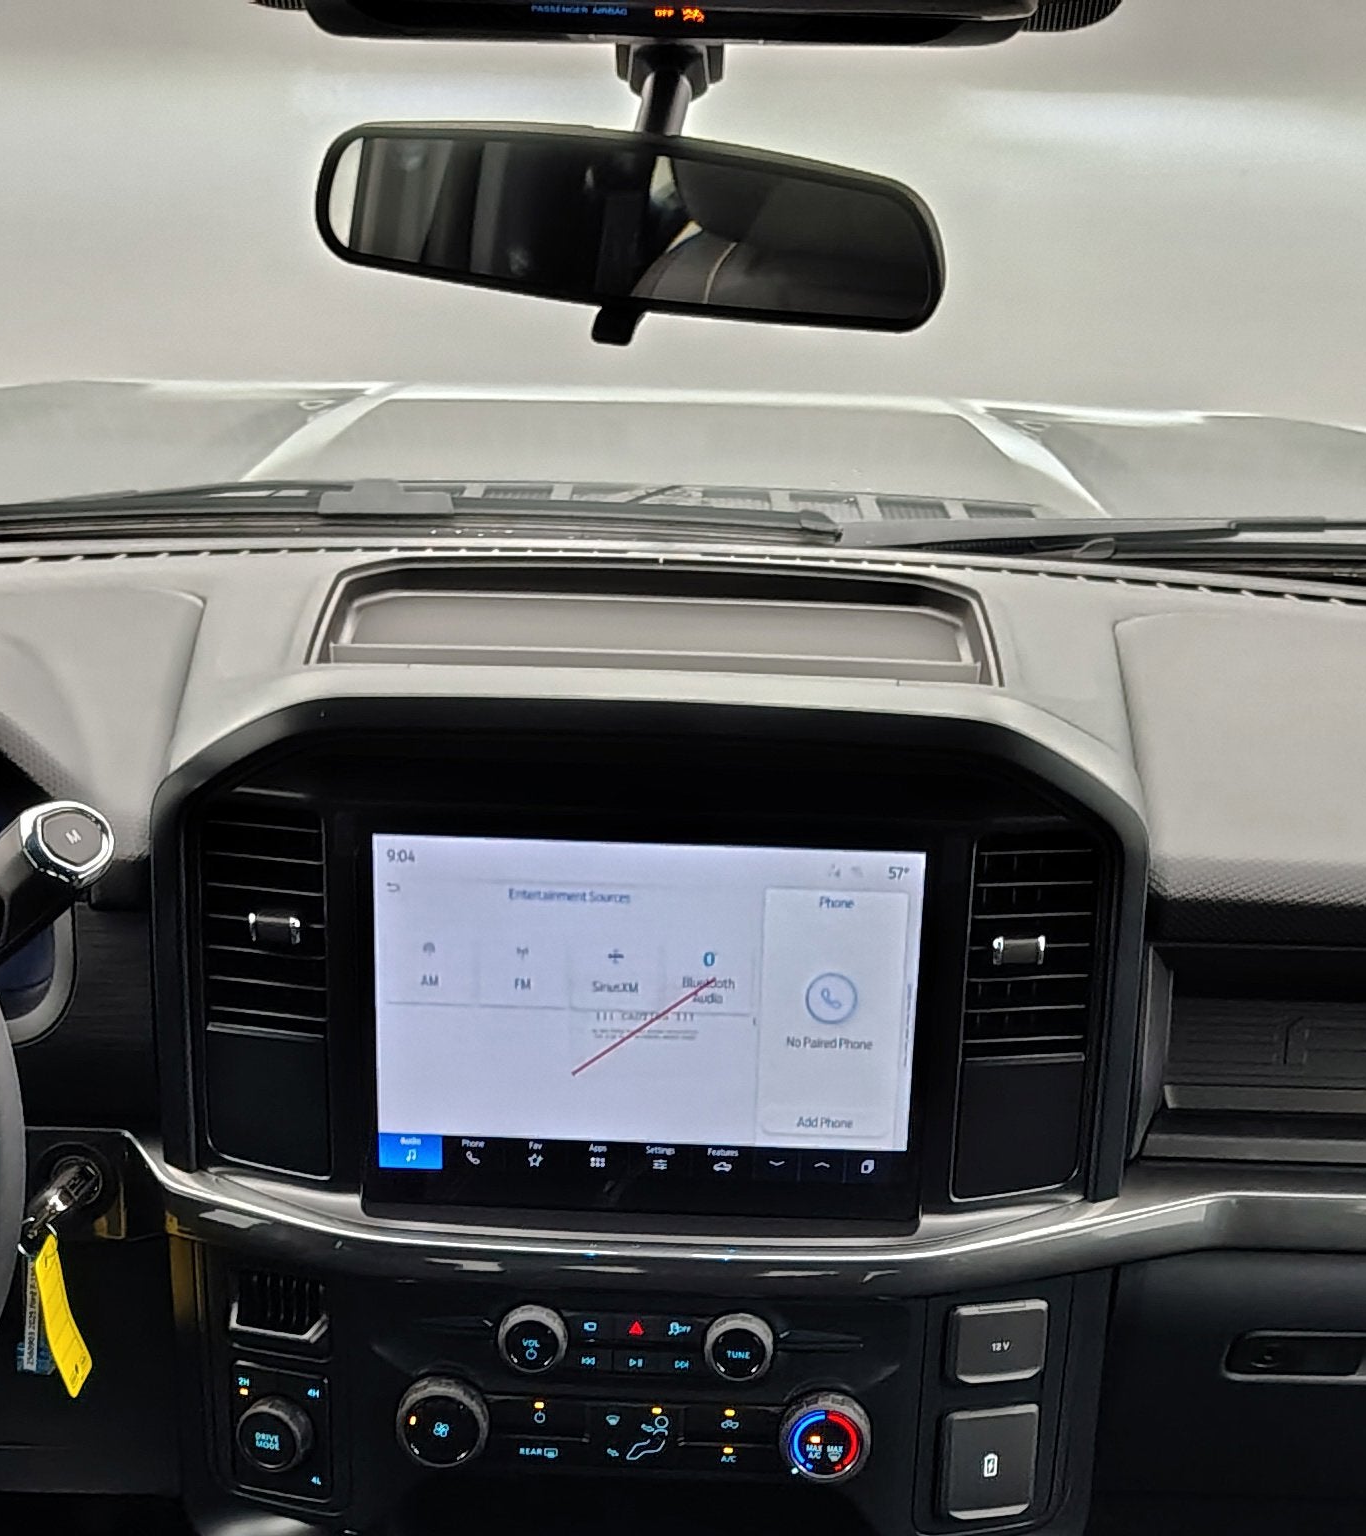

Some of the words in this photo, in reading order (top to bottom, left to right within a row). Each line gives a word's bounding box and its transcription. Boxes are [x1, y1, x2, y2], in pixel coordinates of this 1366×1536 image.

[654, 8, 675, 18] OFF
[65, 829, 82, 845] M
[386, 849, 416, 863] 9:04
[508, 887, 586, 901] Entertainment
[588, 890, 631, 904] Sources
[819, 896, 855, 909] Phone
[420, 974, 439, 986] AM
[514, 978, 532, 990] FM
[591, 981, 639, 993] SiriusXM
[786, 1036, 801, 1048] No
[803, 1037, 837, 1049] Paired
[838, 1038, 873, 1050] Phone
[796, 1115, 819, 1128] Add
[820, 1116, 853, 1129] Phone
[461, 1138, 485, 1149] Phone
[528, 1141, 543, 1150] Fav
[588, 1143, 608, 1154] Apps
[645, 1145, 676, 1156] Settings
[707, 1147, 739, 1158] Features
[522, 1338, 541, 1348] VOL
[726, 1350, 752, 1360] TUNE
[238, 1376, 250, 1387] 2H
[307, 1388, 320, 1399] 4H
[255, 1431, 280, 1443] DRIVE
[255, 1439, 281, 1452] MODE
[806, 1444, 823, 1453] MAX
[826, 1444, 844, 1453] MAX
[519, 1447, 543, 1457] REAR
[808, 1452, 822, 1460] A/C
[720, 1455, 737, 1464] A/C
